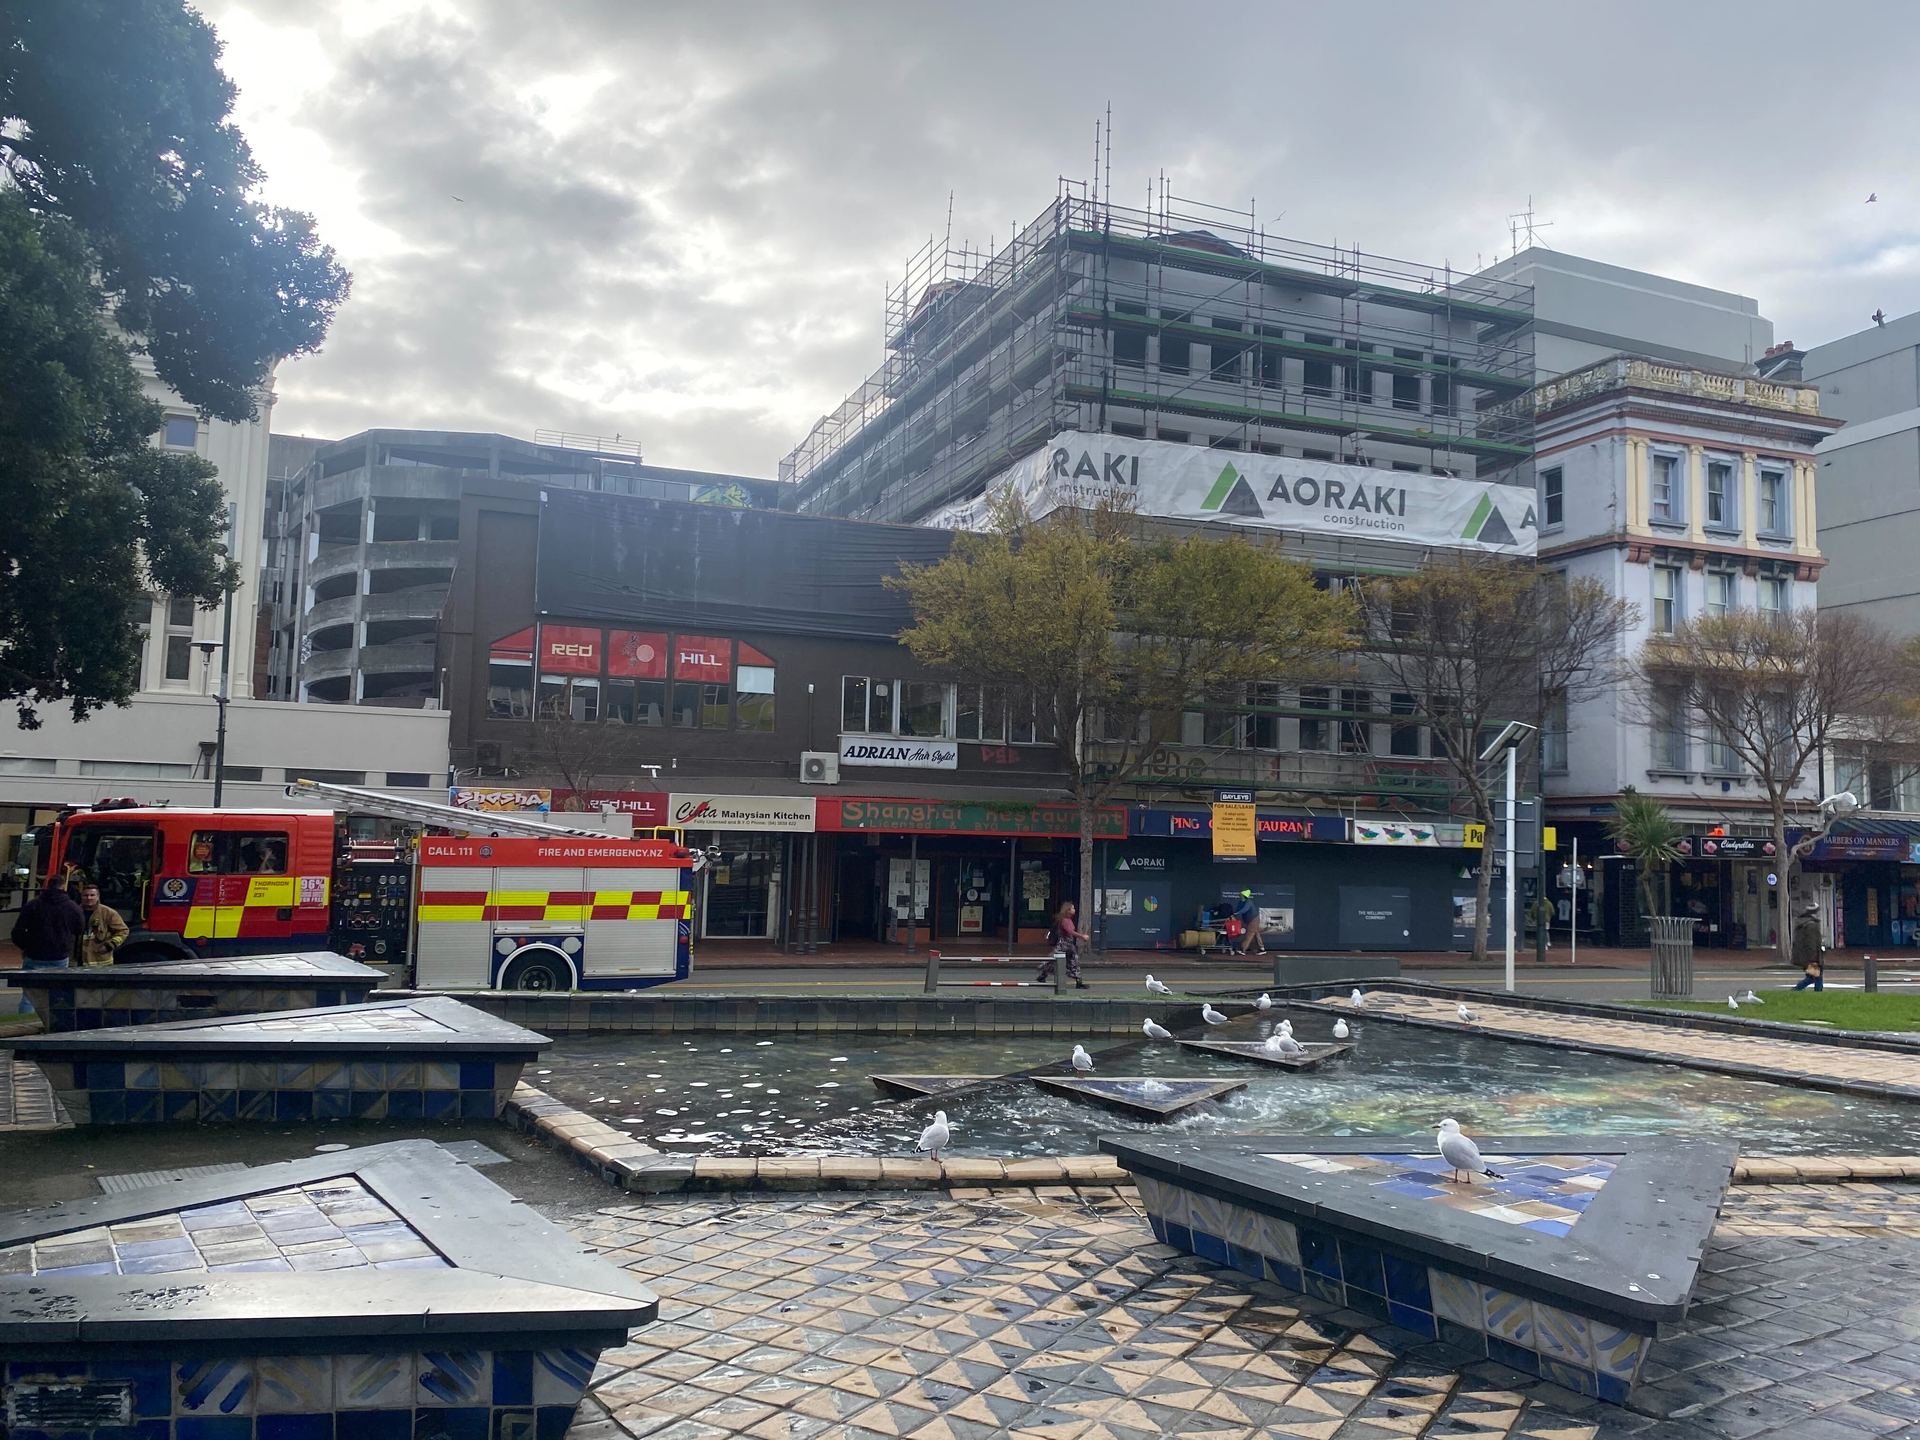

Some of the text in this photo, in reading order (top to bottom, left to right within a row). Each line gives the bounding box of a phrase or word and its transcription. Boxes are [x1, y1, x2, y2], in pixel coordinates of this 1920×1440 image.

[1266, 474, 1406, 517] AORAKI
[1323, 513, 1405, 532] construction
[680, 652, 722, 666] HILL
[843, 745, 911, 760] ADRIAN
[908, 748, 930, 761] Hair
[622, 801, 656, 811] HILL
[721, 810, 770, 821] Malaysian
[773, 811, 811, 821] Kitchen
[843, 801, 1123, 825] Shanghai Restaurnt
[1258, 819, 1314, 834] TAURANT
[428, 846, 473, 856] CALL 111
[538, 848, 663, 858] FIRE AND EMERGENCY.NZ
[1130, 857, 1165, 867] AORAKI
[301, 879, 325, 890] 96%
